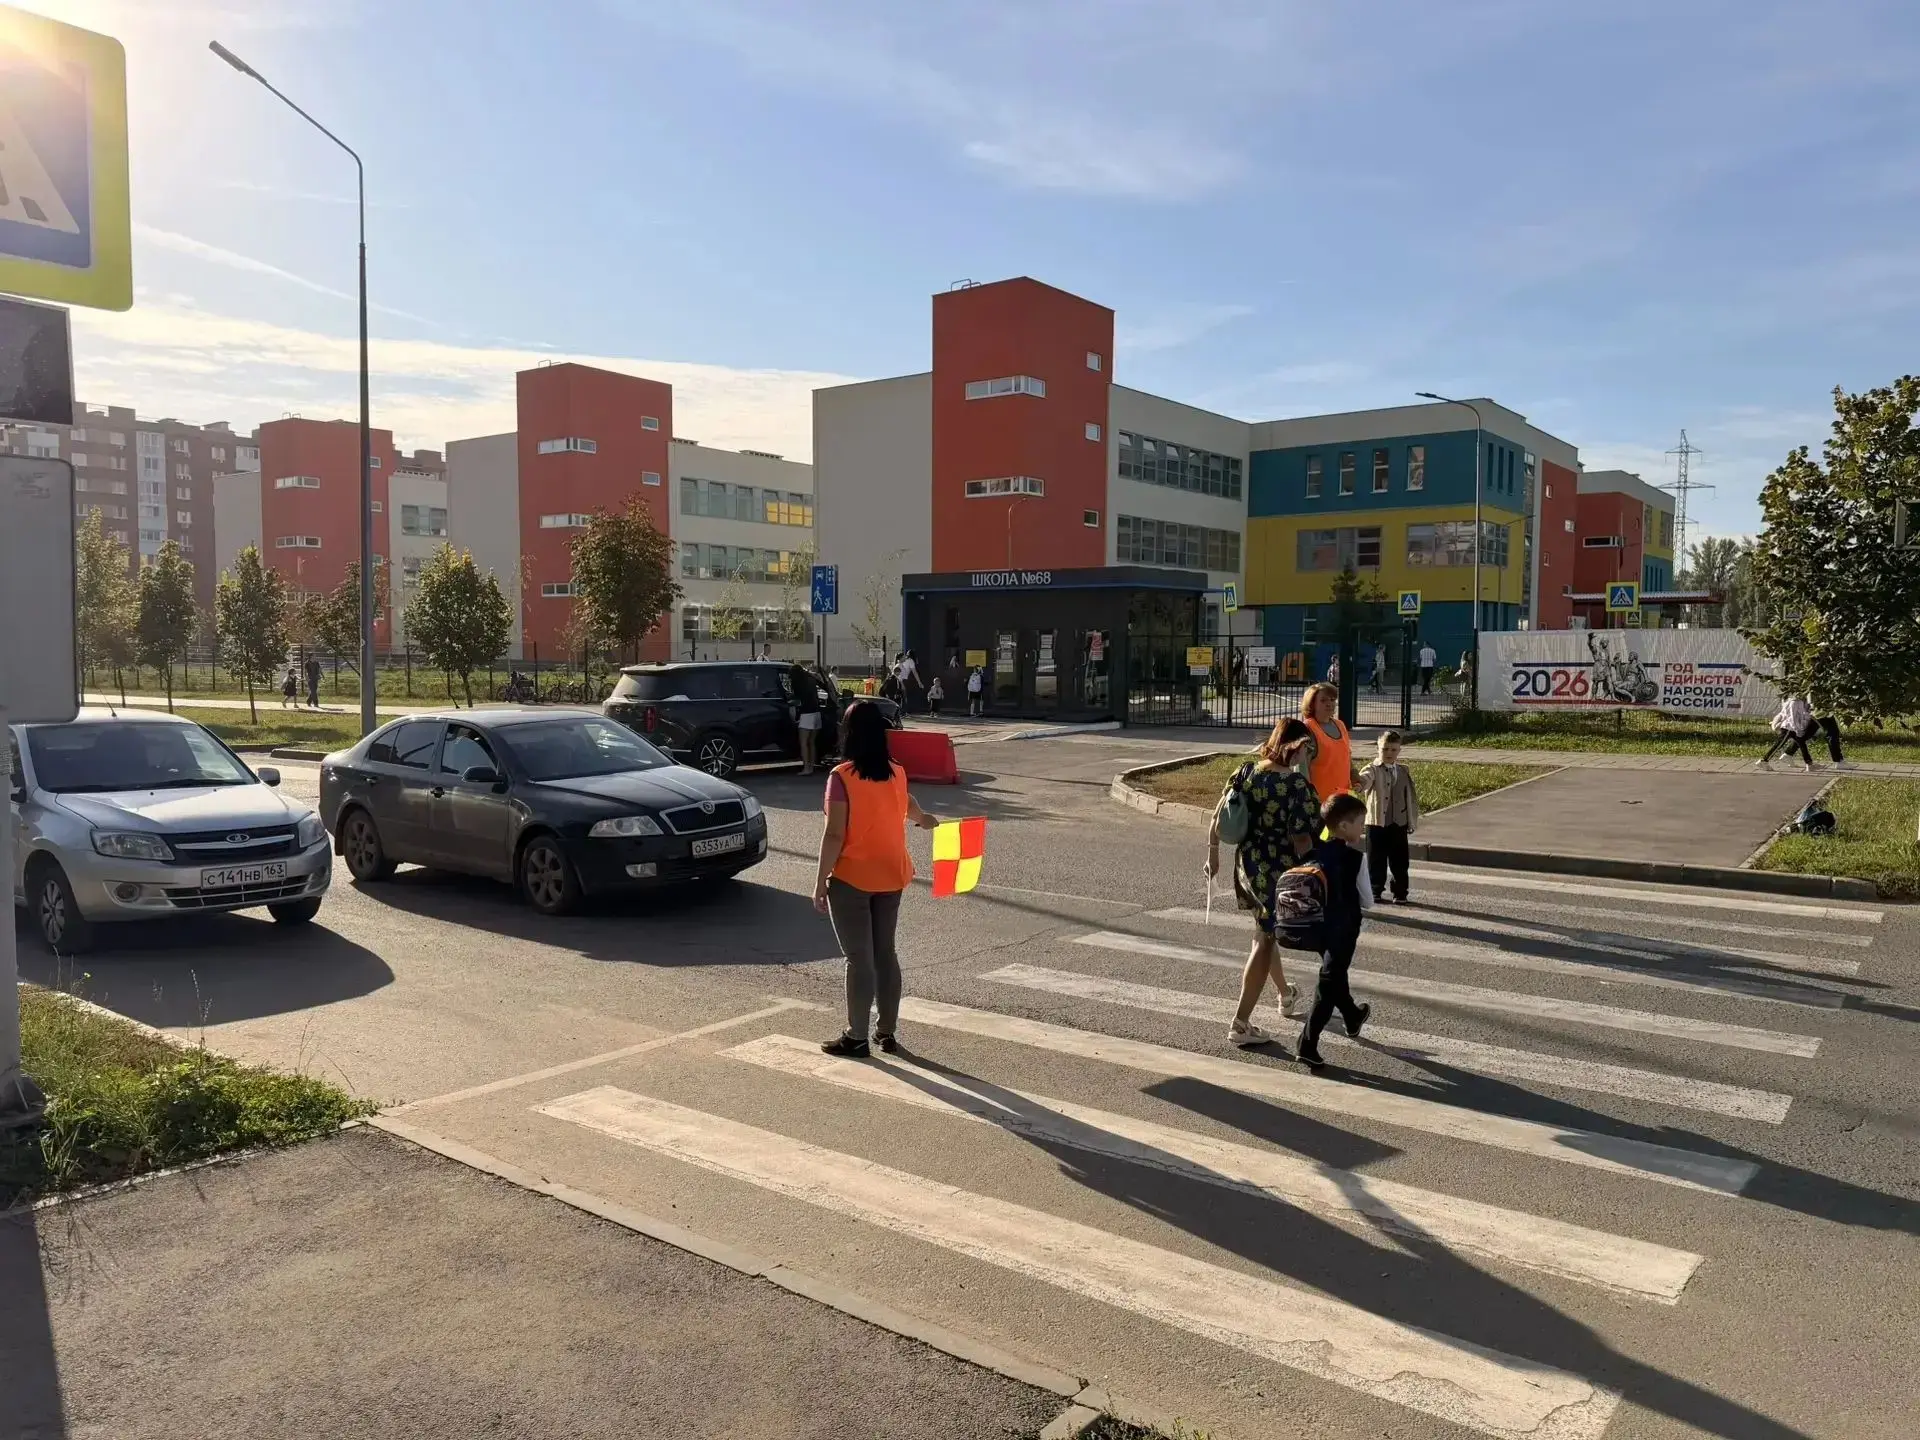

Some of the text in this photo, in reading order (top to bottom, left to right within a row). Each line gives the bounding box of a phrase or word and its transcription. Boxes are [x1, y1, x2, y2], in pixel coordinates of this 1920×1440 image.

[972, 571, 1051, 587] ШКОЛА №68
[1664, 663, 1694, 674] ГОД
[1512, 669, 1590, 697] 2026
[1664, 674, 1743, 685] ЕДИНСТВА
[1663, 686, 1734, 698] НАРОДОВ
[1662, 697, 1725, 709] РОССИИ
[264, 864, 284, 876] 163
